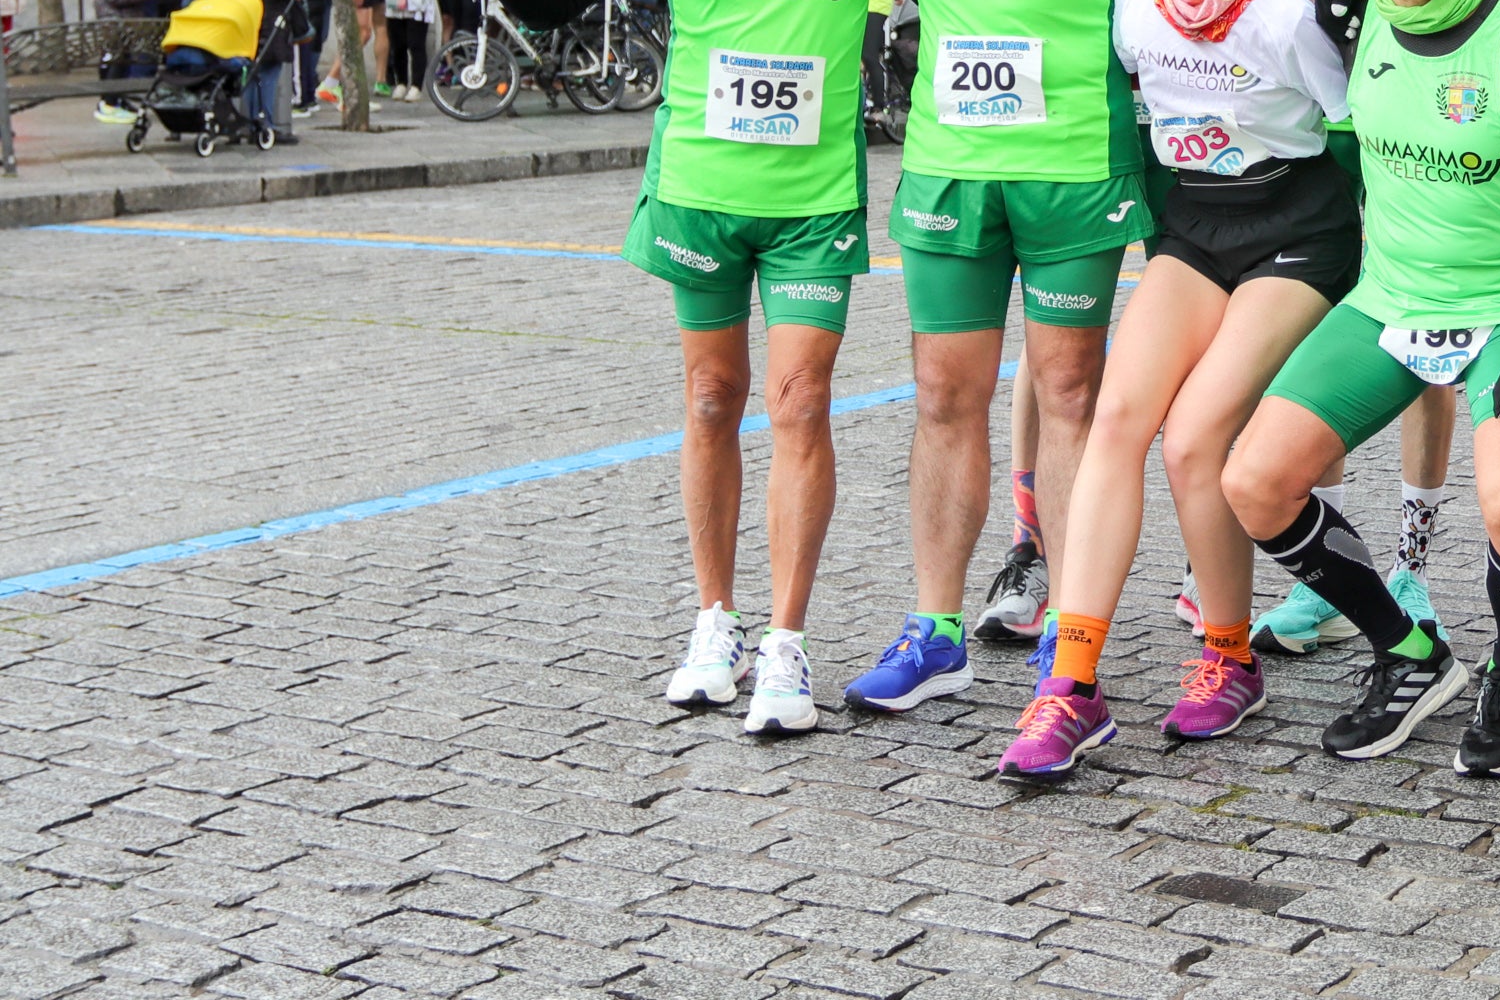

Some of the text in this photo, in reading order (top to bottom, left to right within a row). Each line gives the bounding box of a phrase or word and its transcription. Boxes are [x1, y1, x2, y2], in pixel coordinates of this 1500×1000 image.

[729, 56, 768, 70] CARRERA
[769, 60, 814, 72] SOLIDARIA
[951, 61, 1016, 92] 200
[730, 77, 798, 111] 195
[958, 100, 1016, 116] HESAN
[730, 116, 792, 136] HESAN
[1168, 126, 1230, 162] 203
[1383, 158, 1472, 185] TELECOM
[902, 207, 951, 224] SANMAXIMO
[914, 220, 946, 232] TELECOM
[654, 236, 713, 265] SANMAXIMO
[669, 251, 707, 271] TELECOM
[770, 283, 836, 295] SANMAXIMO
[787, 290, 833, 303] TELECOM
[1025, 283, 1089, 303] SANMAXIMO
[1037, 298, 1085, 310] TELECOM
[1410, 327, 1473, 349] 196
